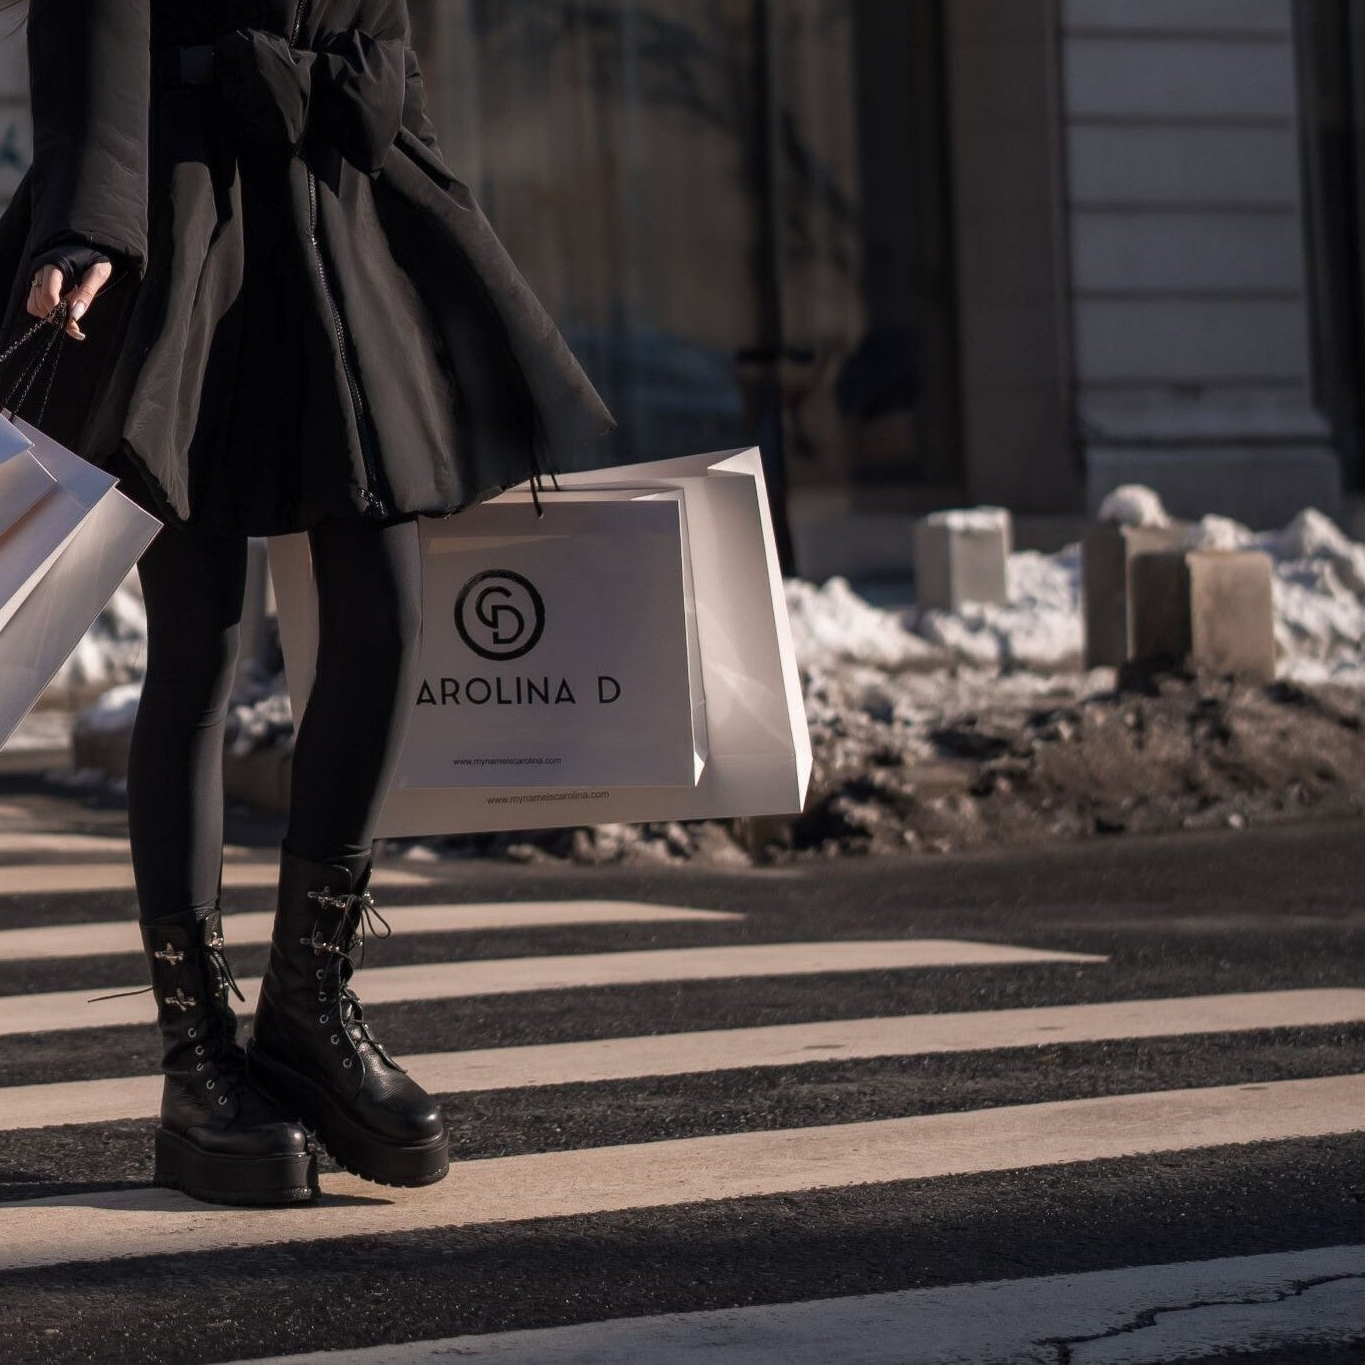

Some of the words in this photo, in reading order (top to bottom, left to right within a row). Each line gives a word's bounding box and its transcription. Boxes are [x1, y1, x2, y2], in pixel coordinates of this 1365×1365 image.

[416, 676, 576, 706] AROLINA
[597, 676, 621, 704] D
[453, 755, 562, 767] www.mynameiscarolina.com
[486, 790, 610, 805] www.mynameiscarolina.com
